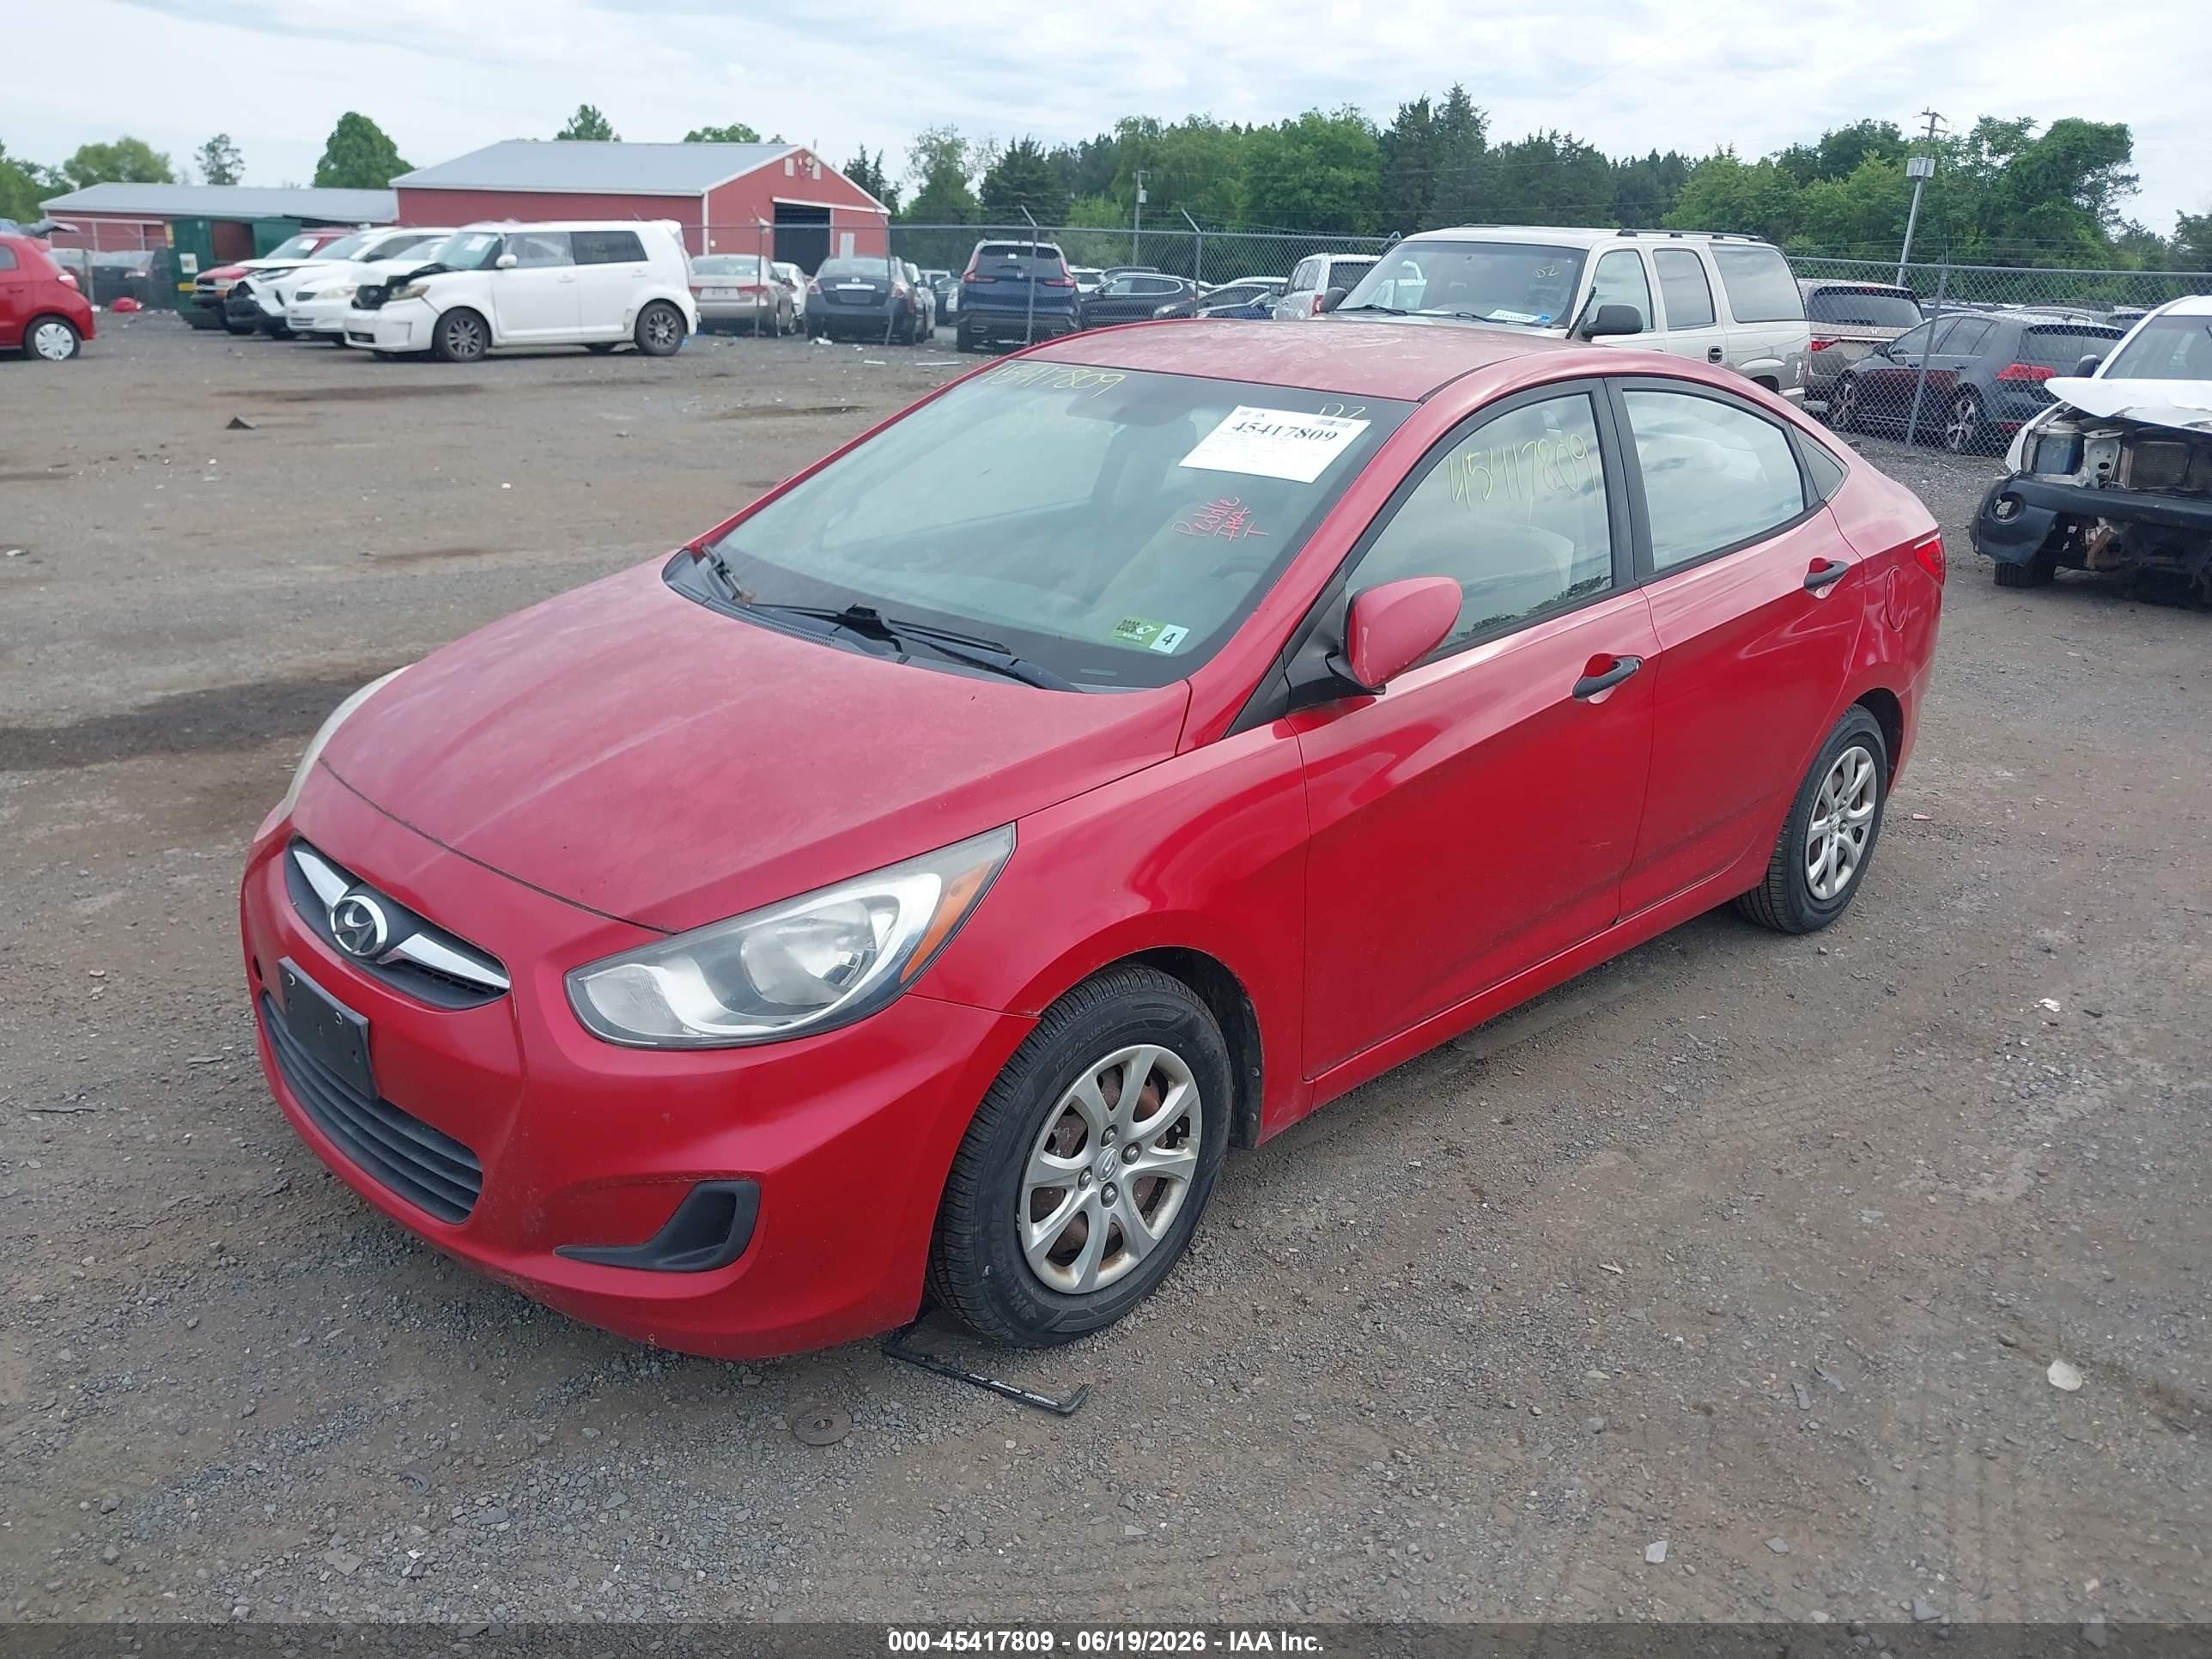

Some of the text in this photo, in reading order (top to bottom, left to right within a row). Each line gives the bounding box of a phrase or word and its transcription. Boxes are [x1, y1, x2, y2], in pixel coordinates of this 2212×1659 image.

[1231, 422, 1339, 442] 45417809
[1449, 434, 1599, 510] 45417809
[1161, 632, 1177, 646] 4
